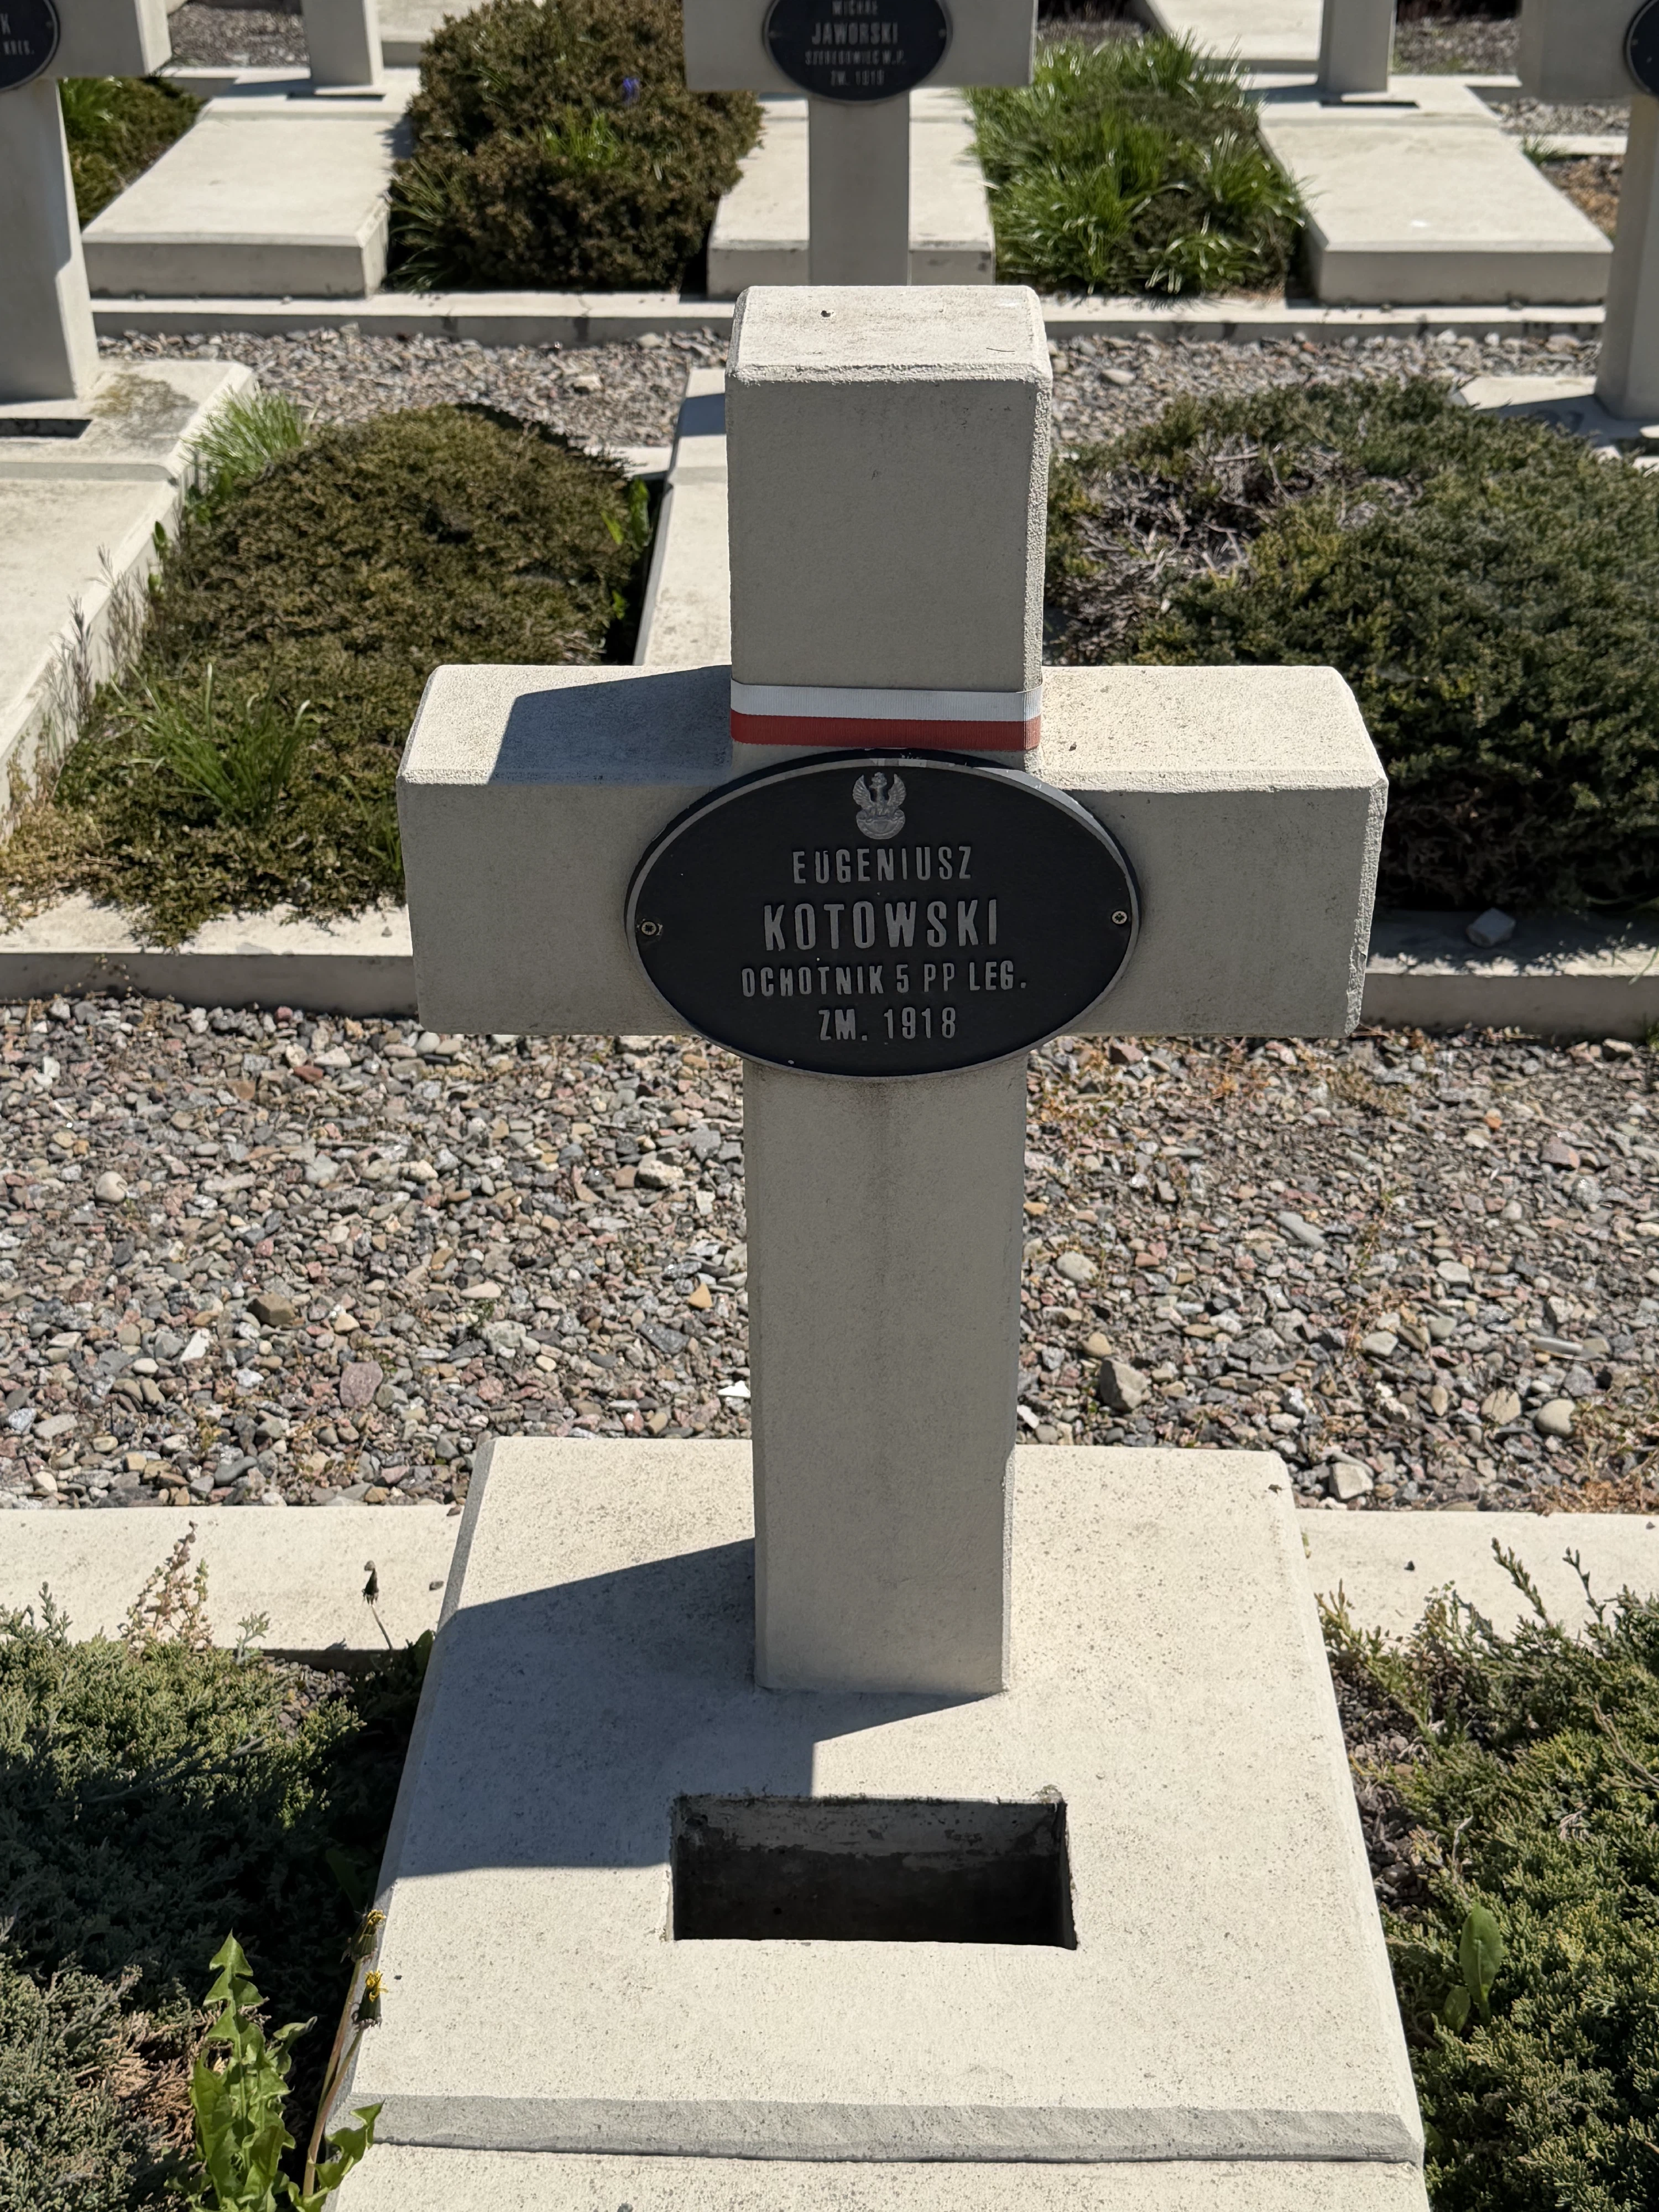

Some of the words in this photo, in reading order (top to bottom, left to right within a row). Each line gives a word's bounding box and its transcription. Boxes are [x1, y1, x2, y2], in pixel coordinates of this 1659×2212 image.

[811, 22, 899, 45] JAWORSKI
[793, 846, 971, 884] EUGENIUSZ
[764, 899, 997, 951] KOTOWSKI
[742, 966, 884, 997] OCHOTNIK
[896, 964, 909, 993] 5
[924, 963, 955, 992] PP
[969, 960, 1026, 991] LEG.
[818, 1009, 868, 1041] ZM.
[884, 1007, 956, 1039] 1918
